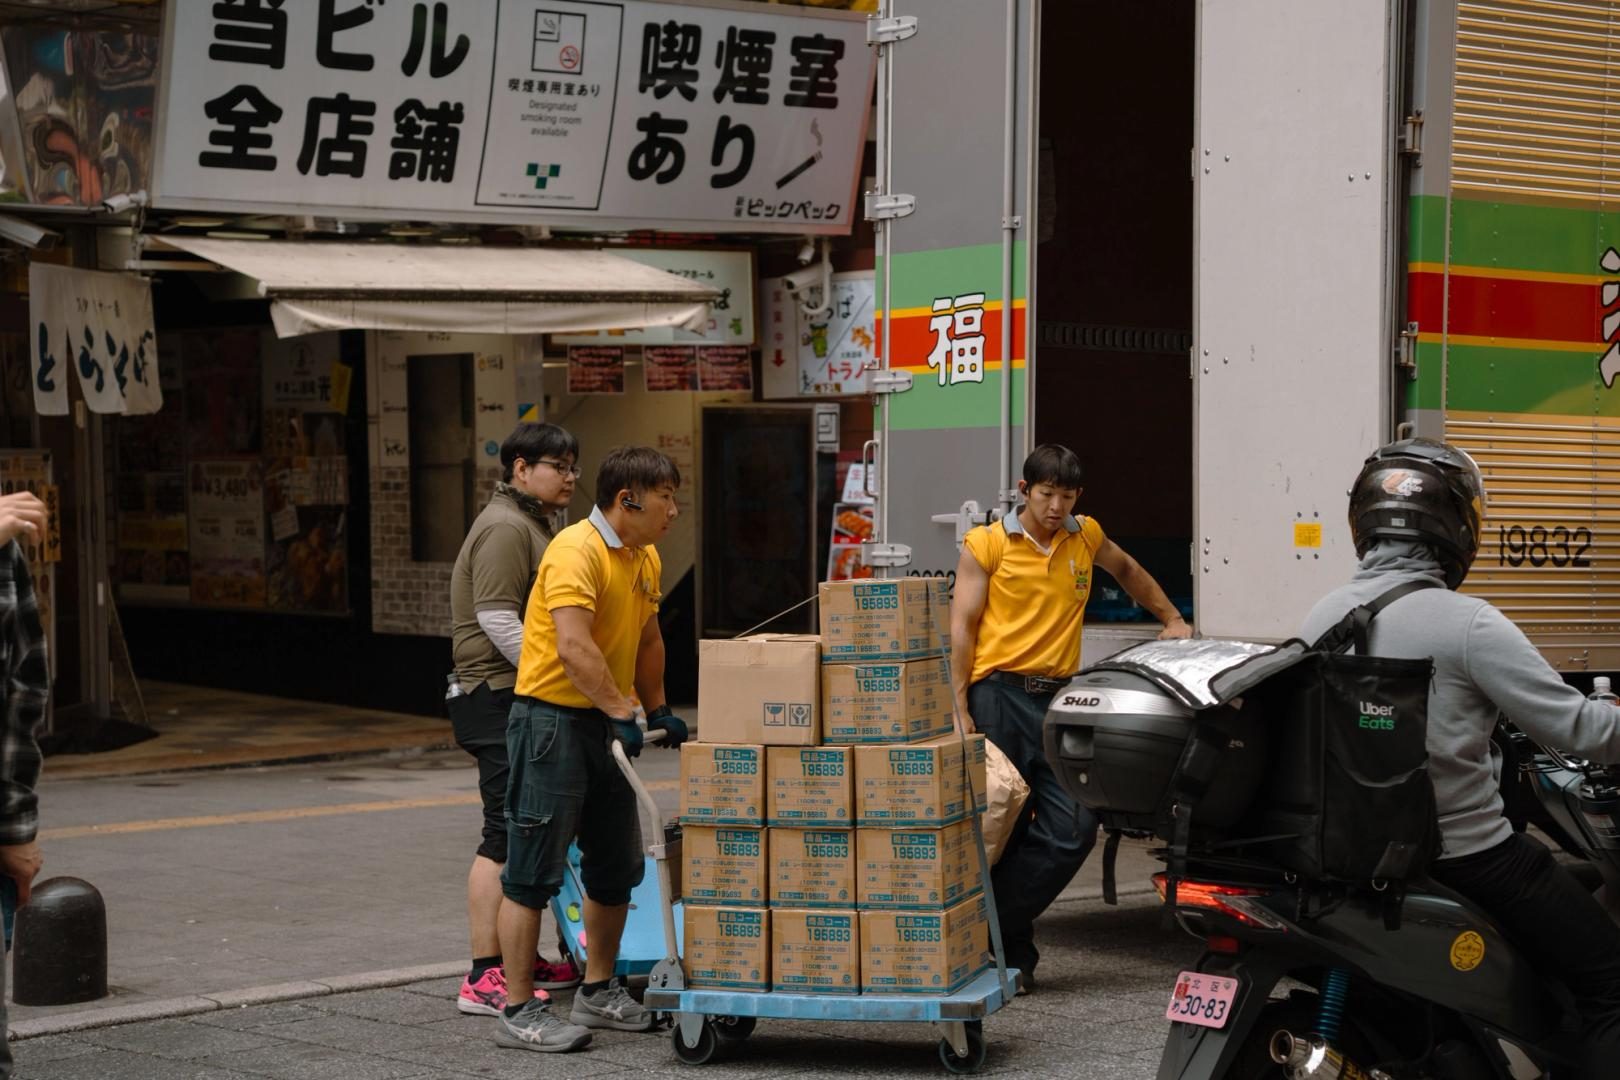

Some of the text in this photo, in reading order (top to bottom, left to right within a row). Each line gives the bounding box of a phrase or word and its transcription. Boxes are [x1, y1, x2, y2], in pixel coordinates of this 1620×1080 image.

[209, 0, 470, 78] 当ビル
[639, 20, 845, 109] 喫煙室
[529, 99, 577, 112] Designated
[520, 114, 582, 125] smoking room
[199, 85, 464, 182] 全店舗
[531, 128, 568, 137] available
[627, 112, 755, 189] あり
[927, 291, 986, 387] 福
[855, 596, 897, 610] 195893
[856, 679, 899, 692] 195893
[1062, 696, 1100, 707] SHAD
[1359, 701, 1394, 717] Uber
[1358, 718, 1395, 730] Eats
[715, 761, 756, 774] 195893
[801, 764, 843, 775] 195893
[890, 762, 933, 775] 195893
[717, 843, 758, 856] 195893
[805, 845, 847, 857] 195893
[892, 846, 935, 858] 195893
[718, 924, 760, 937] 195893
[807, 928, 850, 941] 195893
[897, 929, 940, 941] 195893
